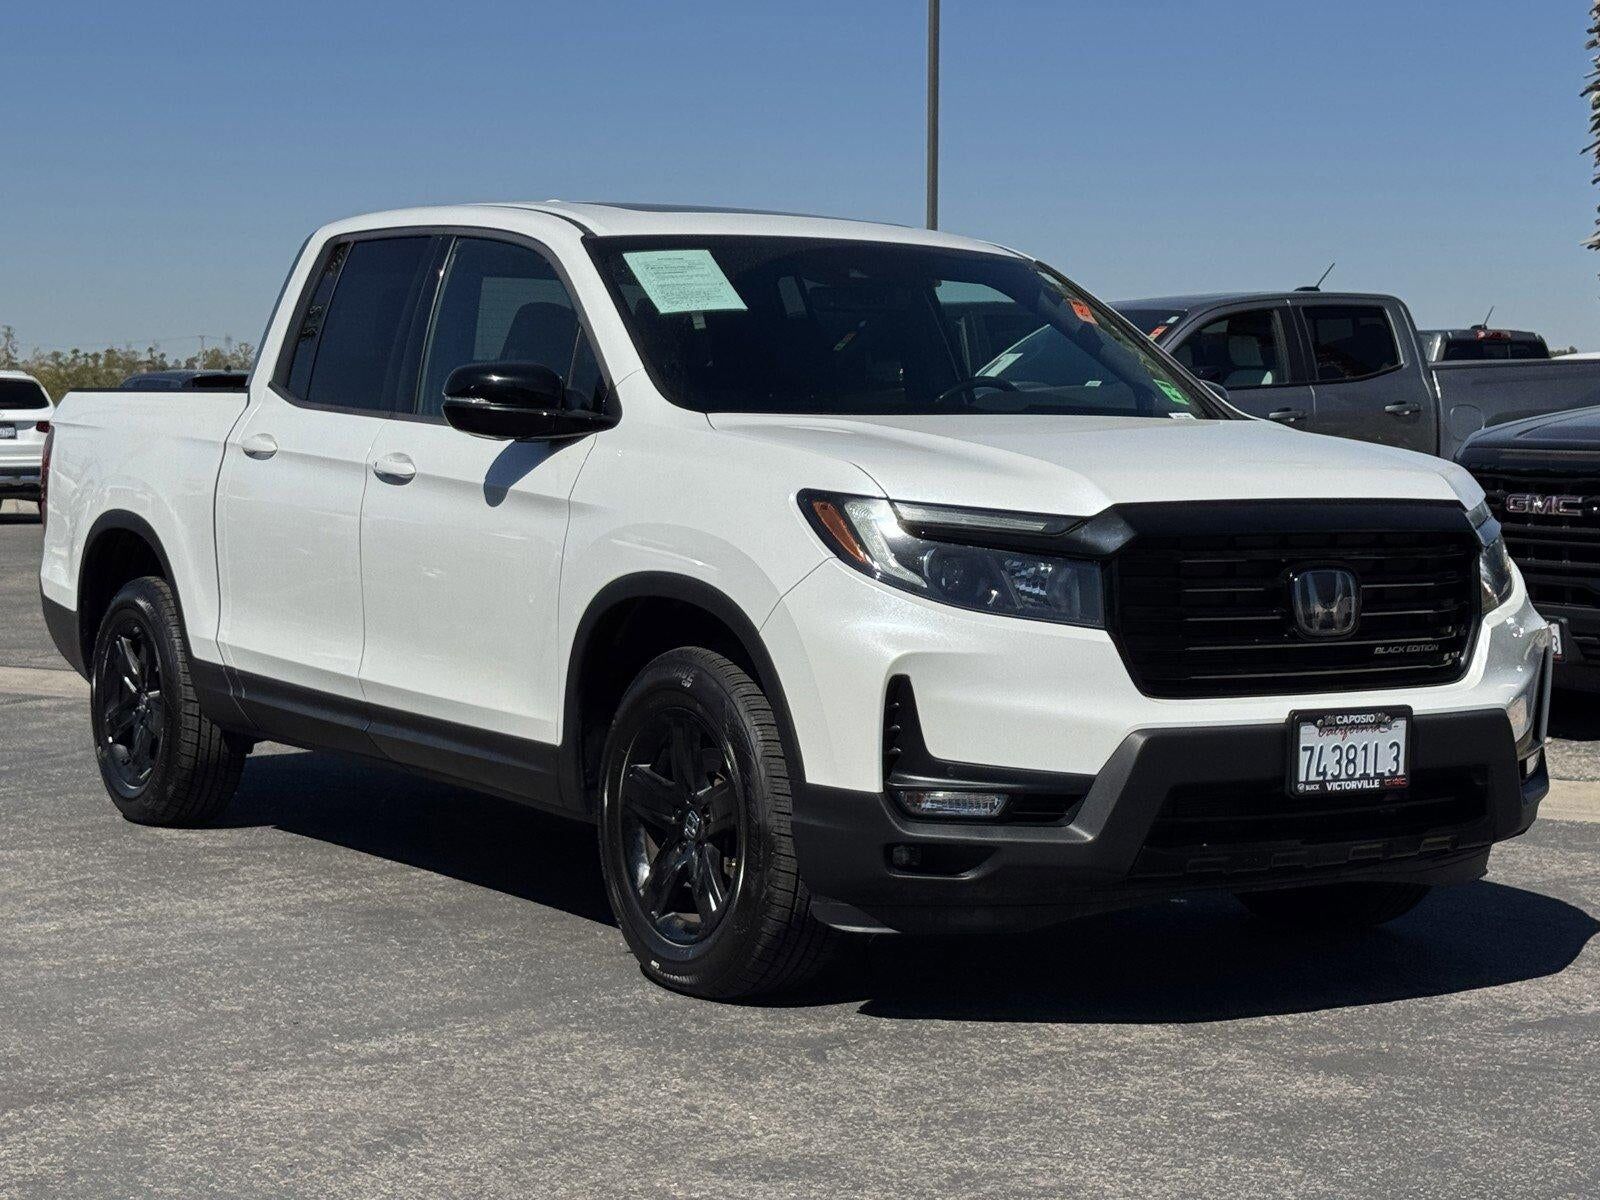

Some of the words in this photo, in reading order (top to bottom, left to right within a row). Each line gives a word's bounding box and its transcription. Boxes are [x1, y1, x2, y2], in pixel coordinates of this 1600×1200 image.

[1506, 494, 1583, 516] GMC
[1374, 646, 1405, 655] BLACK
[1406, 644, 1440, 653] EDITION
[1336, 714, 1376, 725] CAPOSIO
[1301, 741, 1401, 781] 74381L3
[1325, 779, 1380, 791] VICTORVILLE
